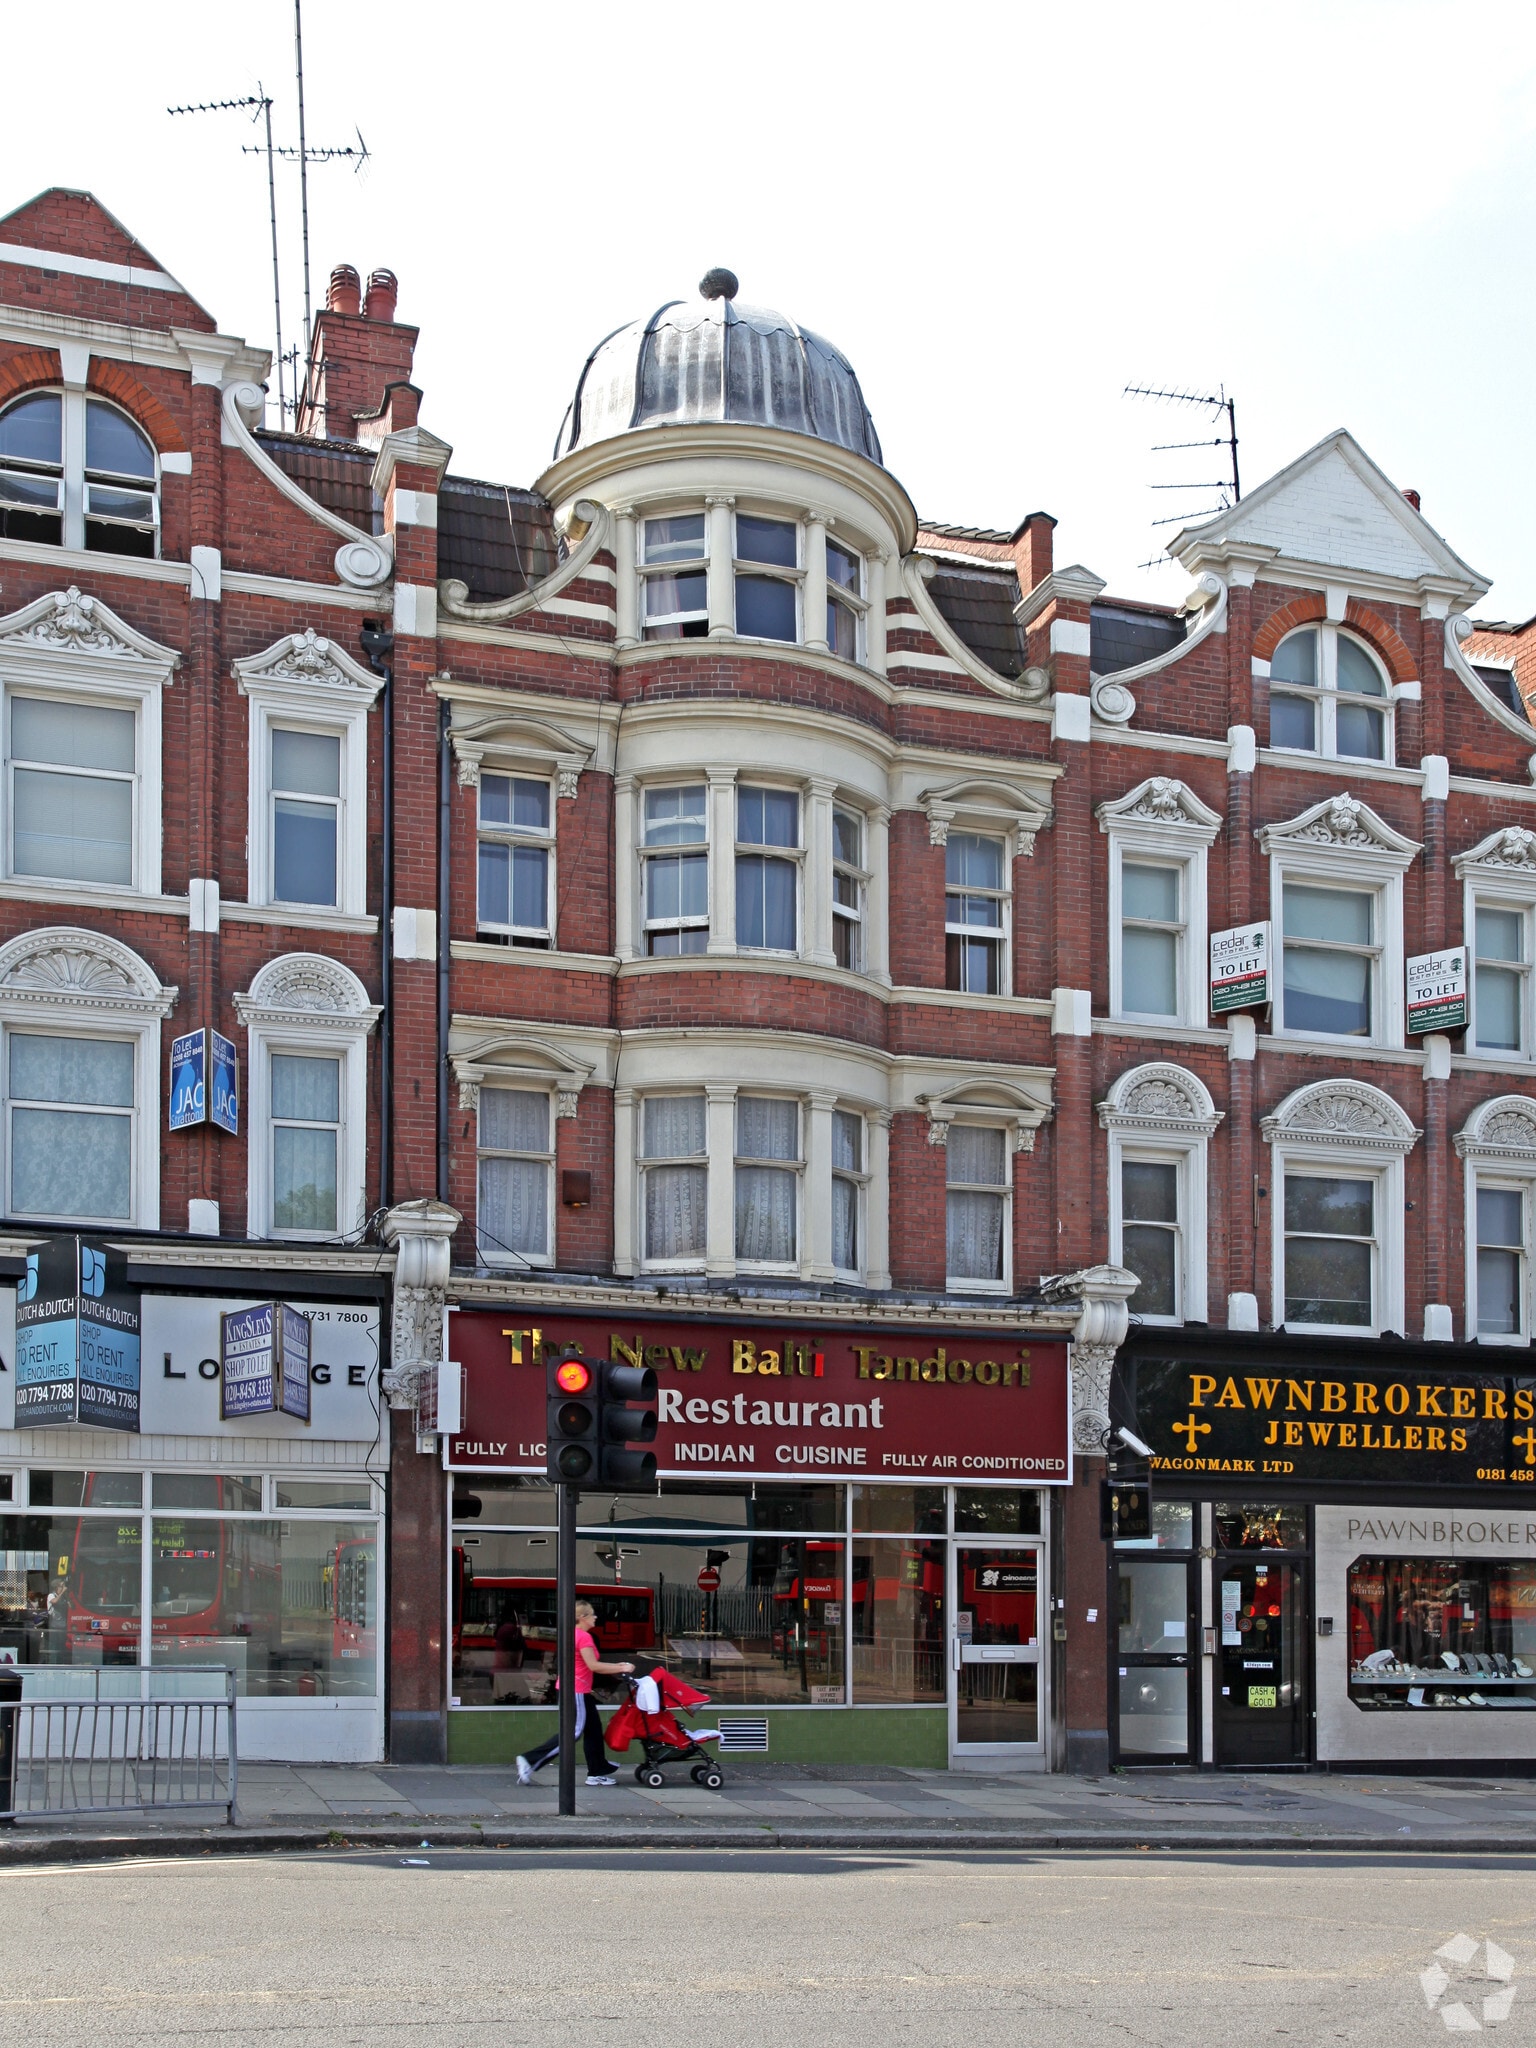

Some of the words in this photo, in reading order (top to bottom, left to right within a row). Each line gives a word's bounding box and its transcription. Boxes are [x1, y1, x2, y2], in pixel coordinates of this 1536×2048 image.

[1213, 931, 1248, 952] cedar
[1213, 946, 1249, 957] estates
[1219, 964, 1235, 976] TO
[1240, 958, 1260, 972] LET
[1410, 955, 1446, 976] cedar
[1410, 970, 1447, 981] estates
[1213, 986, 1230, 996] 020
[1416, 988, 1432, 1000] TO
[1437, 982, 1458, 996] LET
[1410, 1010, 1426, 1018] 020
[174, 1042, 180, 1054] To
[182, 1039, 192, 1052] Let
[213, 1034, 218, 1047] To
[176, 1081, 203, 1114] JAC
[216, 1086, 236, 1120] JAC
[171, 1110, 204, 1127] Strattons
[17, 1304, 38, 1322] DUTCH
[38, 1304, 45, 1318] &
[46, 1298, 74, 1316] DUTCH
[82, 1298, 105, 1318] DUTCH
[106, 1306, 112, 1321] &
[112, 1308, 138, 1328] DUTCH
[302, 1310, 330, 1321] 8731
[336, 1312, 368, 1323] 7800
[18, 1330, 33, 1345] SHOP
[82, 1324, 100, 1340] SHOP
[18, 1348, 26, 1366] TO
[29, 1342, 58, 1363] RENT
[82, 1341, 94, 1361] TO
[96, 1346, 124, 1368] RENT
[239, 1338, 262, 1352] ESTATES
[164, 1352, 366, 1386] LOGE
[226, 1358, 244, 1378] SHOP
[246, 1356, 256, 1374] TO
[257, 1354, 268, 1372] LET
[610, 1334, 708, 1372] New
[732, 1338, 824, 1378] Balti
[852, 1345, 1030, 1386] Tandoori
[17, 1369, 26, 1384] ALL
[28, 1363, 70, 1380] ENQUIRIES
[82, 1366, 94, 1379] ALL
[96, 1369, 134, 1387] ENQUIRIES
[16, 1388, 27, 1405] 020
[28, 1386, 48, 1403] 7794
[50, 1383, 74, 1400] 7788
[82, 1384, 96, 1401] 020
[96, 1388, 116, 1405] 7794
[118, 1391, 138, 1410] 7788
[226, 1382, 256, 1402] 020-8458
[256, 1378, 272, 1398] 3333
[1189, 1374, 1534, 1420] PAWNBROKERS
[658, 1389, 884, 1429] Restaurant
[1264, 1420, 1467, 1452] JEWELLERS
[456, 1442, 508, 1456] FULLY
[674, 1442, 755, 1462] INDIAN
[775, 1444, 866, 1466] CUISINE
[882, 1453, 928, 1468] FULLY
[932, 1454, 958, 1469] AIR
[961, 1455, 1066, 1471] CONDITIONED
[1148, 1456, 1255, 1473] WAGONMARK
[1262, 1460, 1294, 1474] LTD
[1476, 1468, 1506, 1480] 0181
[1510, 1470, 1534, 1481] 458
[1250, 1687, 1268, 1695] CASH
[1270, 1687, 1275, 1695] 4
[1254, 1698, 1272, 1706] GOLD
